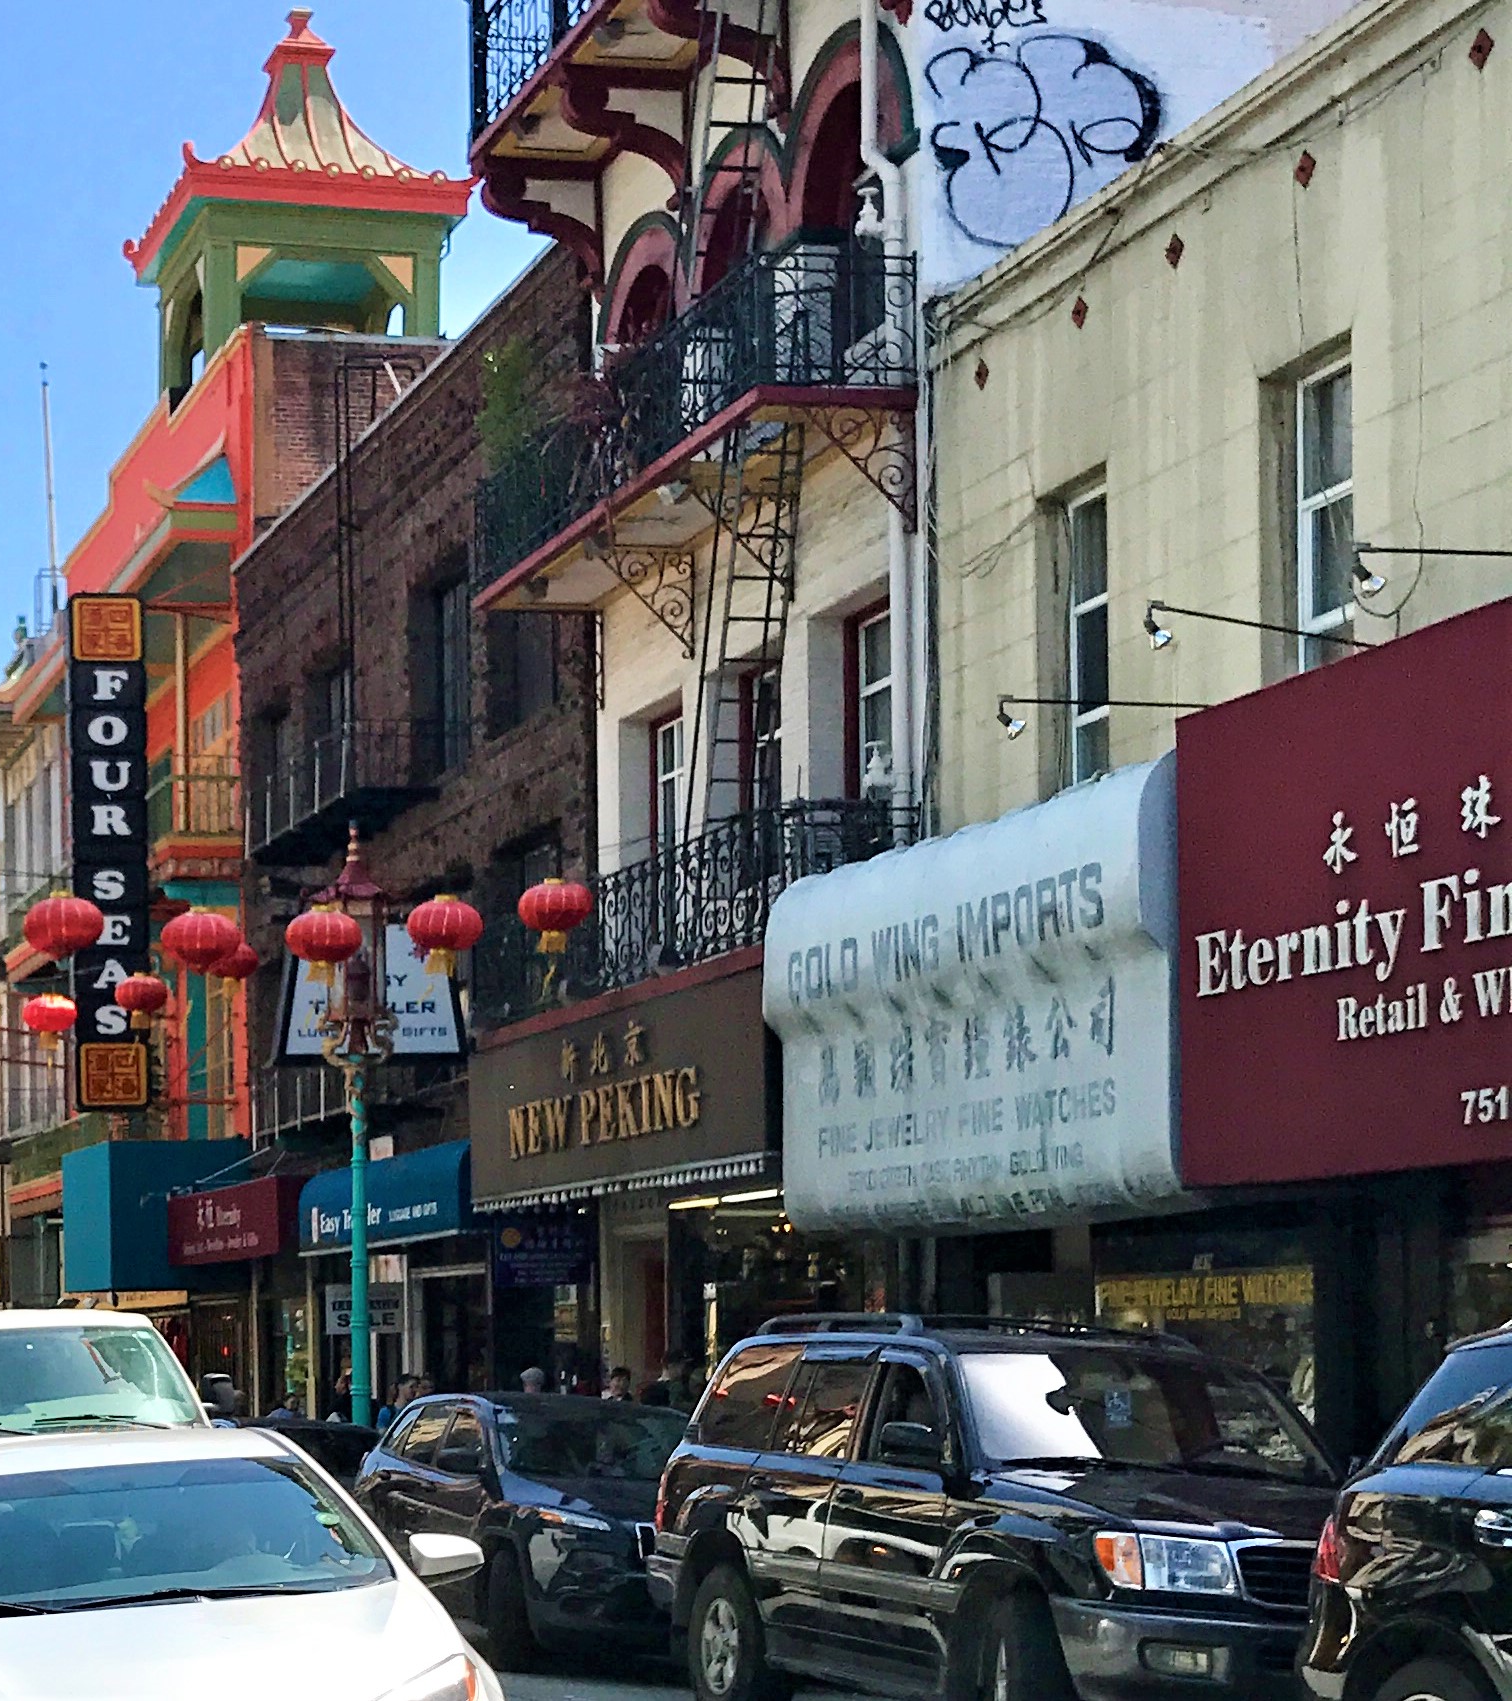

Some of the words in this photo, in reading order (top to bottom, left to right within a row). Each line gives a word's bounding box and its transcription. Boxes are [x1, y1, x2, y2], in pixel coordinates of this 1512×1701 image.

[87, 669, 131, 837] FOUR
[92, 870, 131, 1036] SEAS
[788, 937, 858, 1008] GOLD
[872, 914, 939, 988] WING
[956, 862, 1104, 963] IMPORTS
[1195, 899, 1406, 997] Eternity
[1336, 983, 1428, 1041] Retail
[1440, 976, 1463, 1024] &
[1472, 967, 1512, 1016] W
[508, 1094, 572, 1160] NEW
[580, 1065, 701, 1146] PEKING
[819, 1122, 857, 1158] FINE
[864, 1107, 949, 1152] JEWELRY
[959, 1097, 1003, 1136] FINE
[1015, 1077, 1116, 1131] WATCHES
[1459, 1088, 1509, 1125] 751
[320, 1213, 341, 1237] Easy
[342, 1202, 381, 1230] Trler
[337, 1313, 395, 1327] SLE
